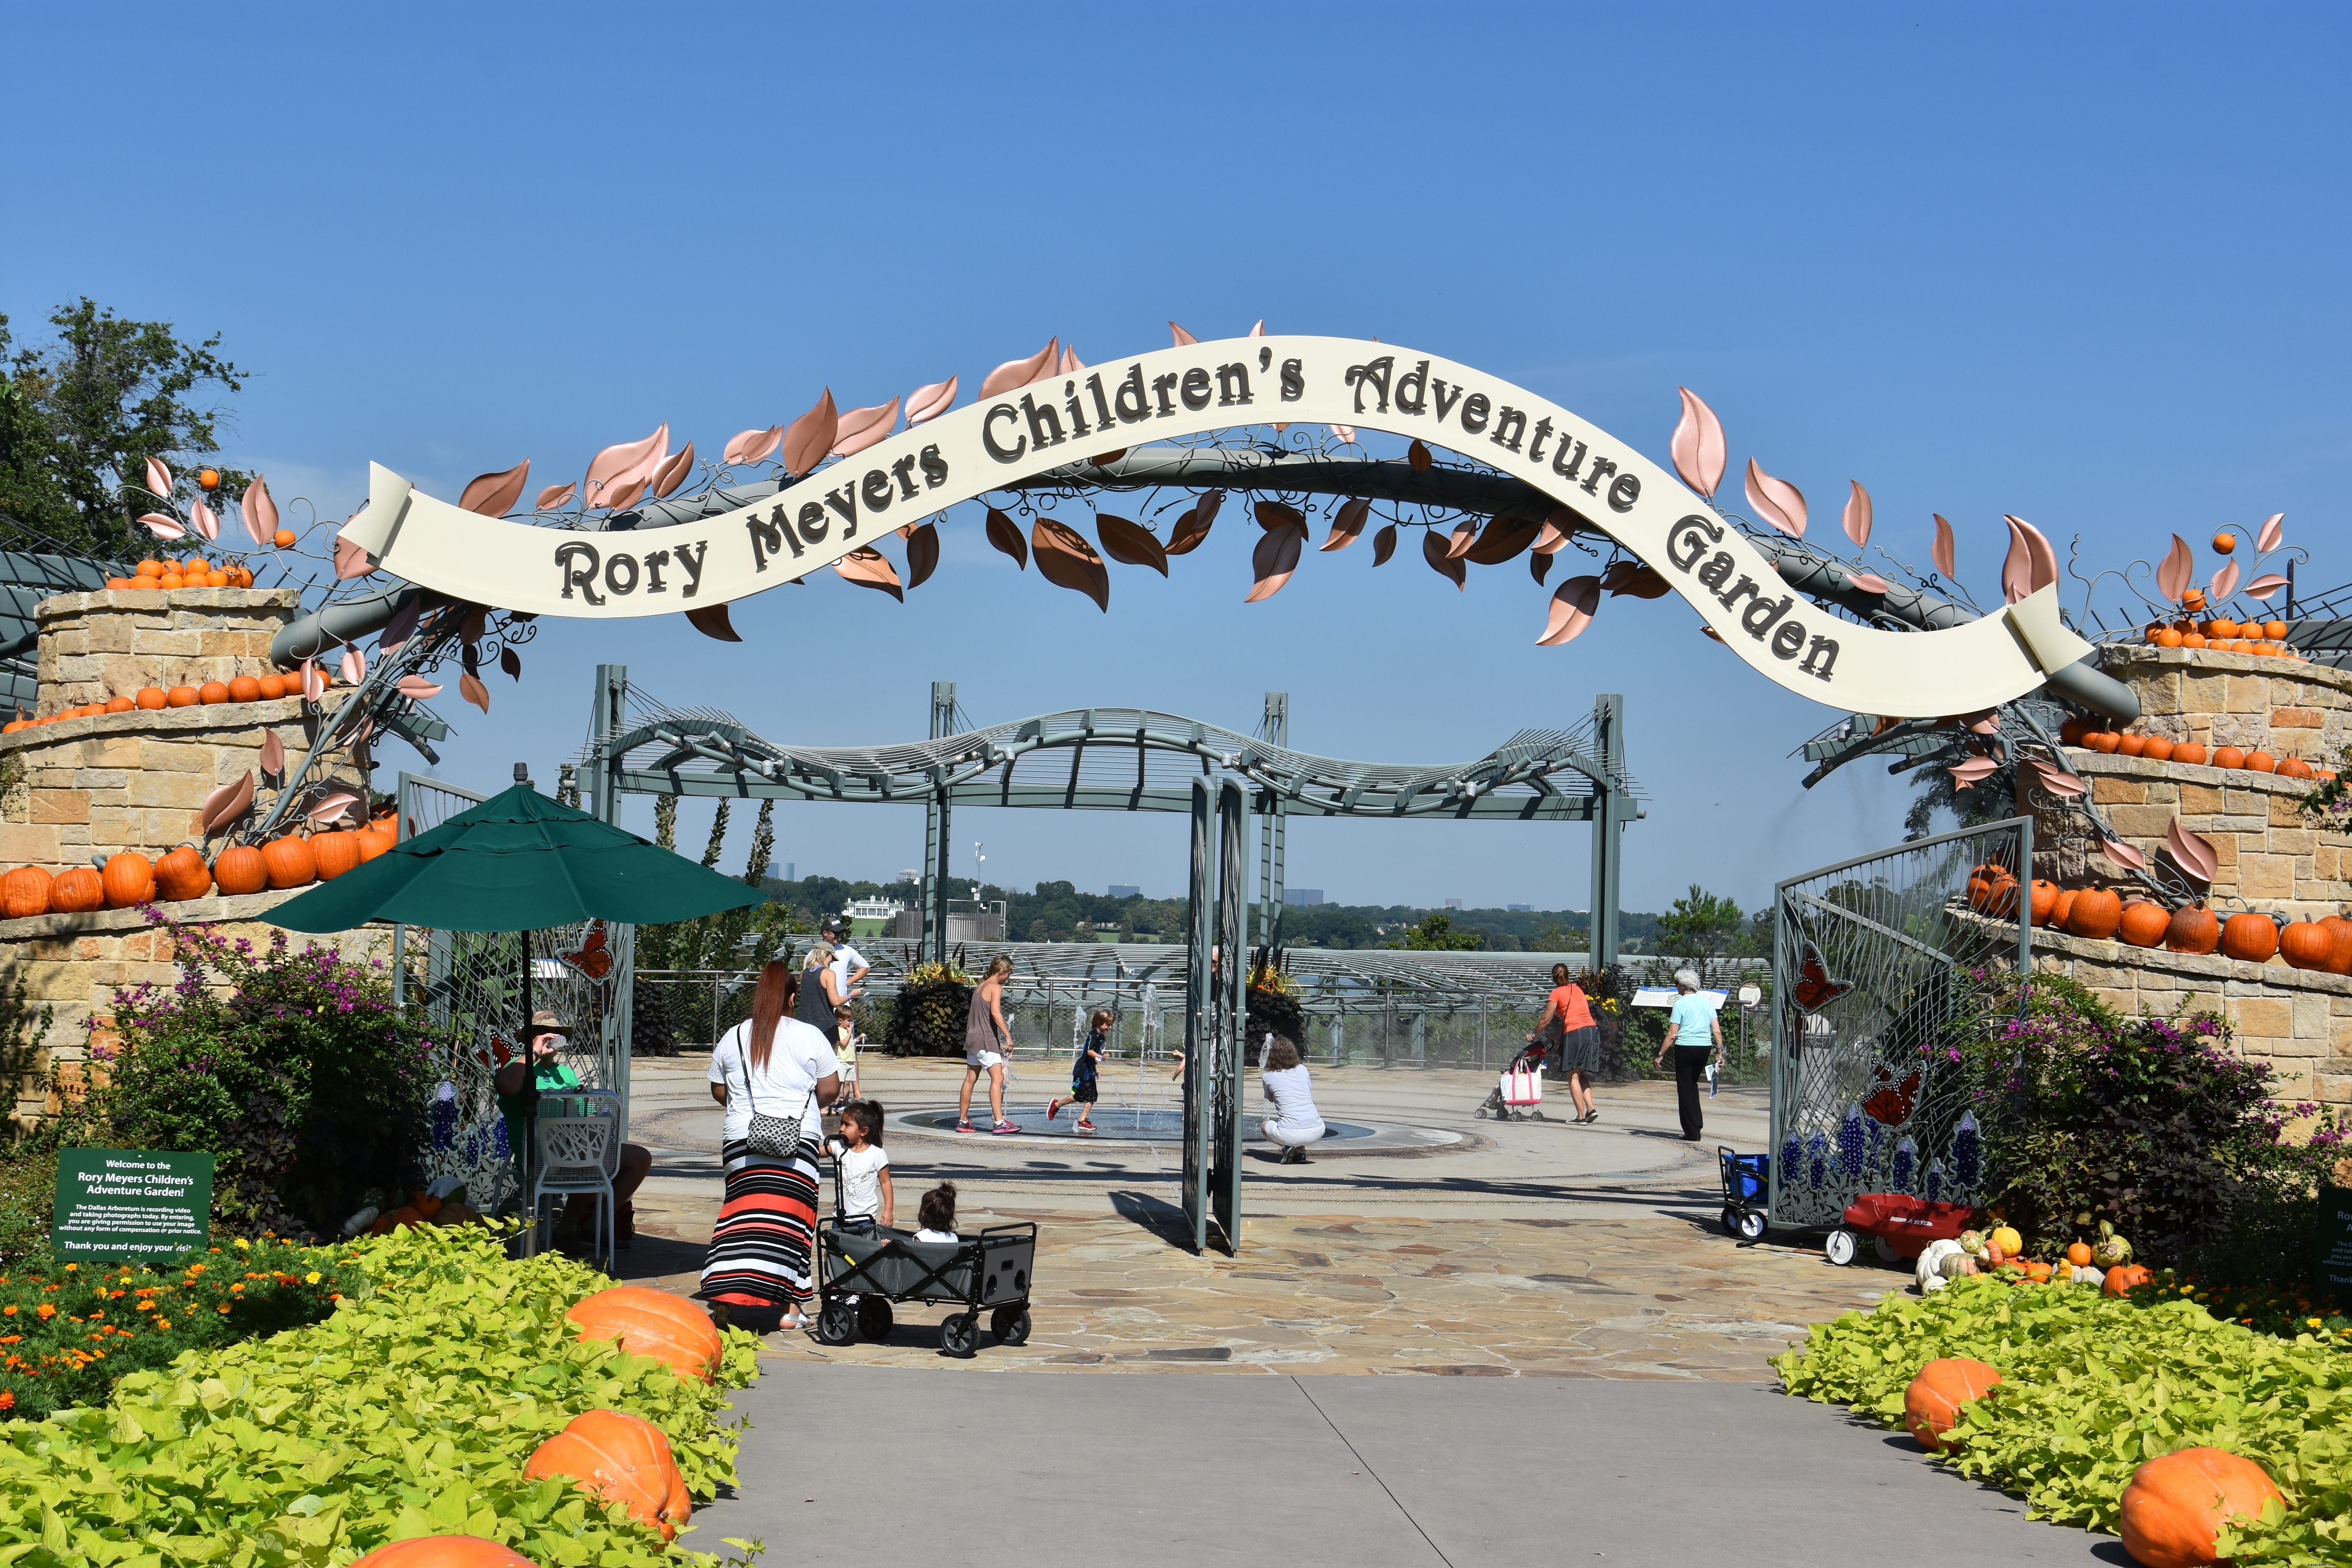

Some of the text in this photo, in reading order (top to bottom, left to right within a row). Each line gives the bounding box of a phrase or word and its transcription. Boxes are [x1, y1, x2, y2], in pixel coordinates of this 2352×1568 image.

[555, 347, 1839, 680] Rory Meyers Children's Adventure Garden
[78, 1172, 193, 1185] Rory Meyers Children's
[87, 1185, 183, 1196] Adventure Garden!
[129, 1243, 153, 1252] enjoy
